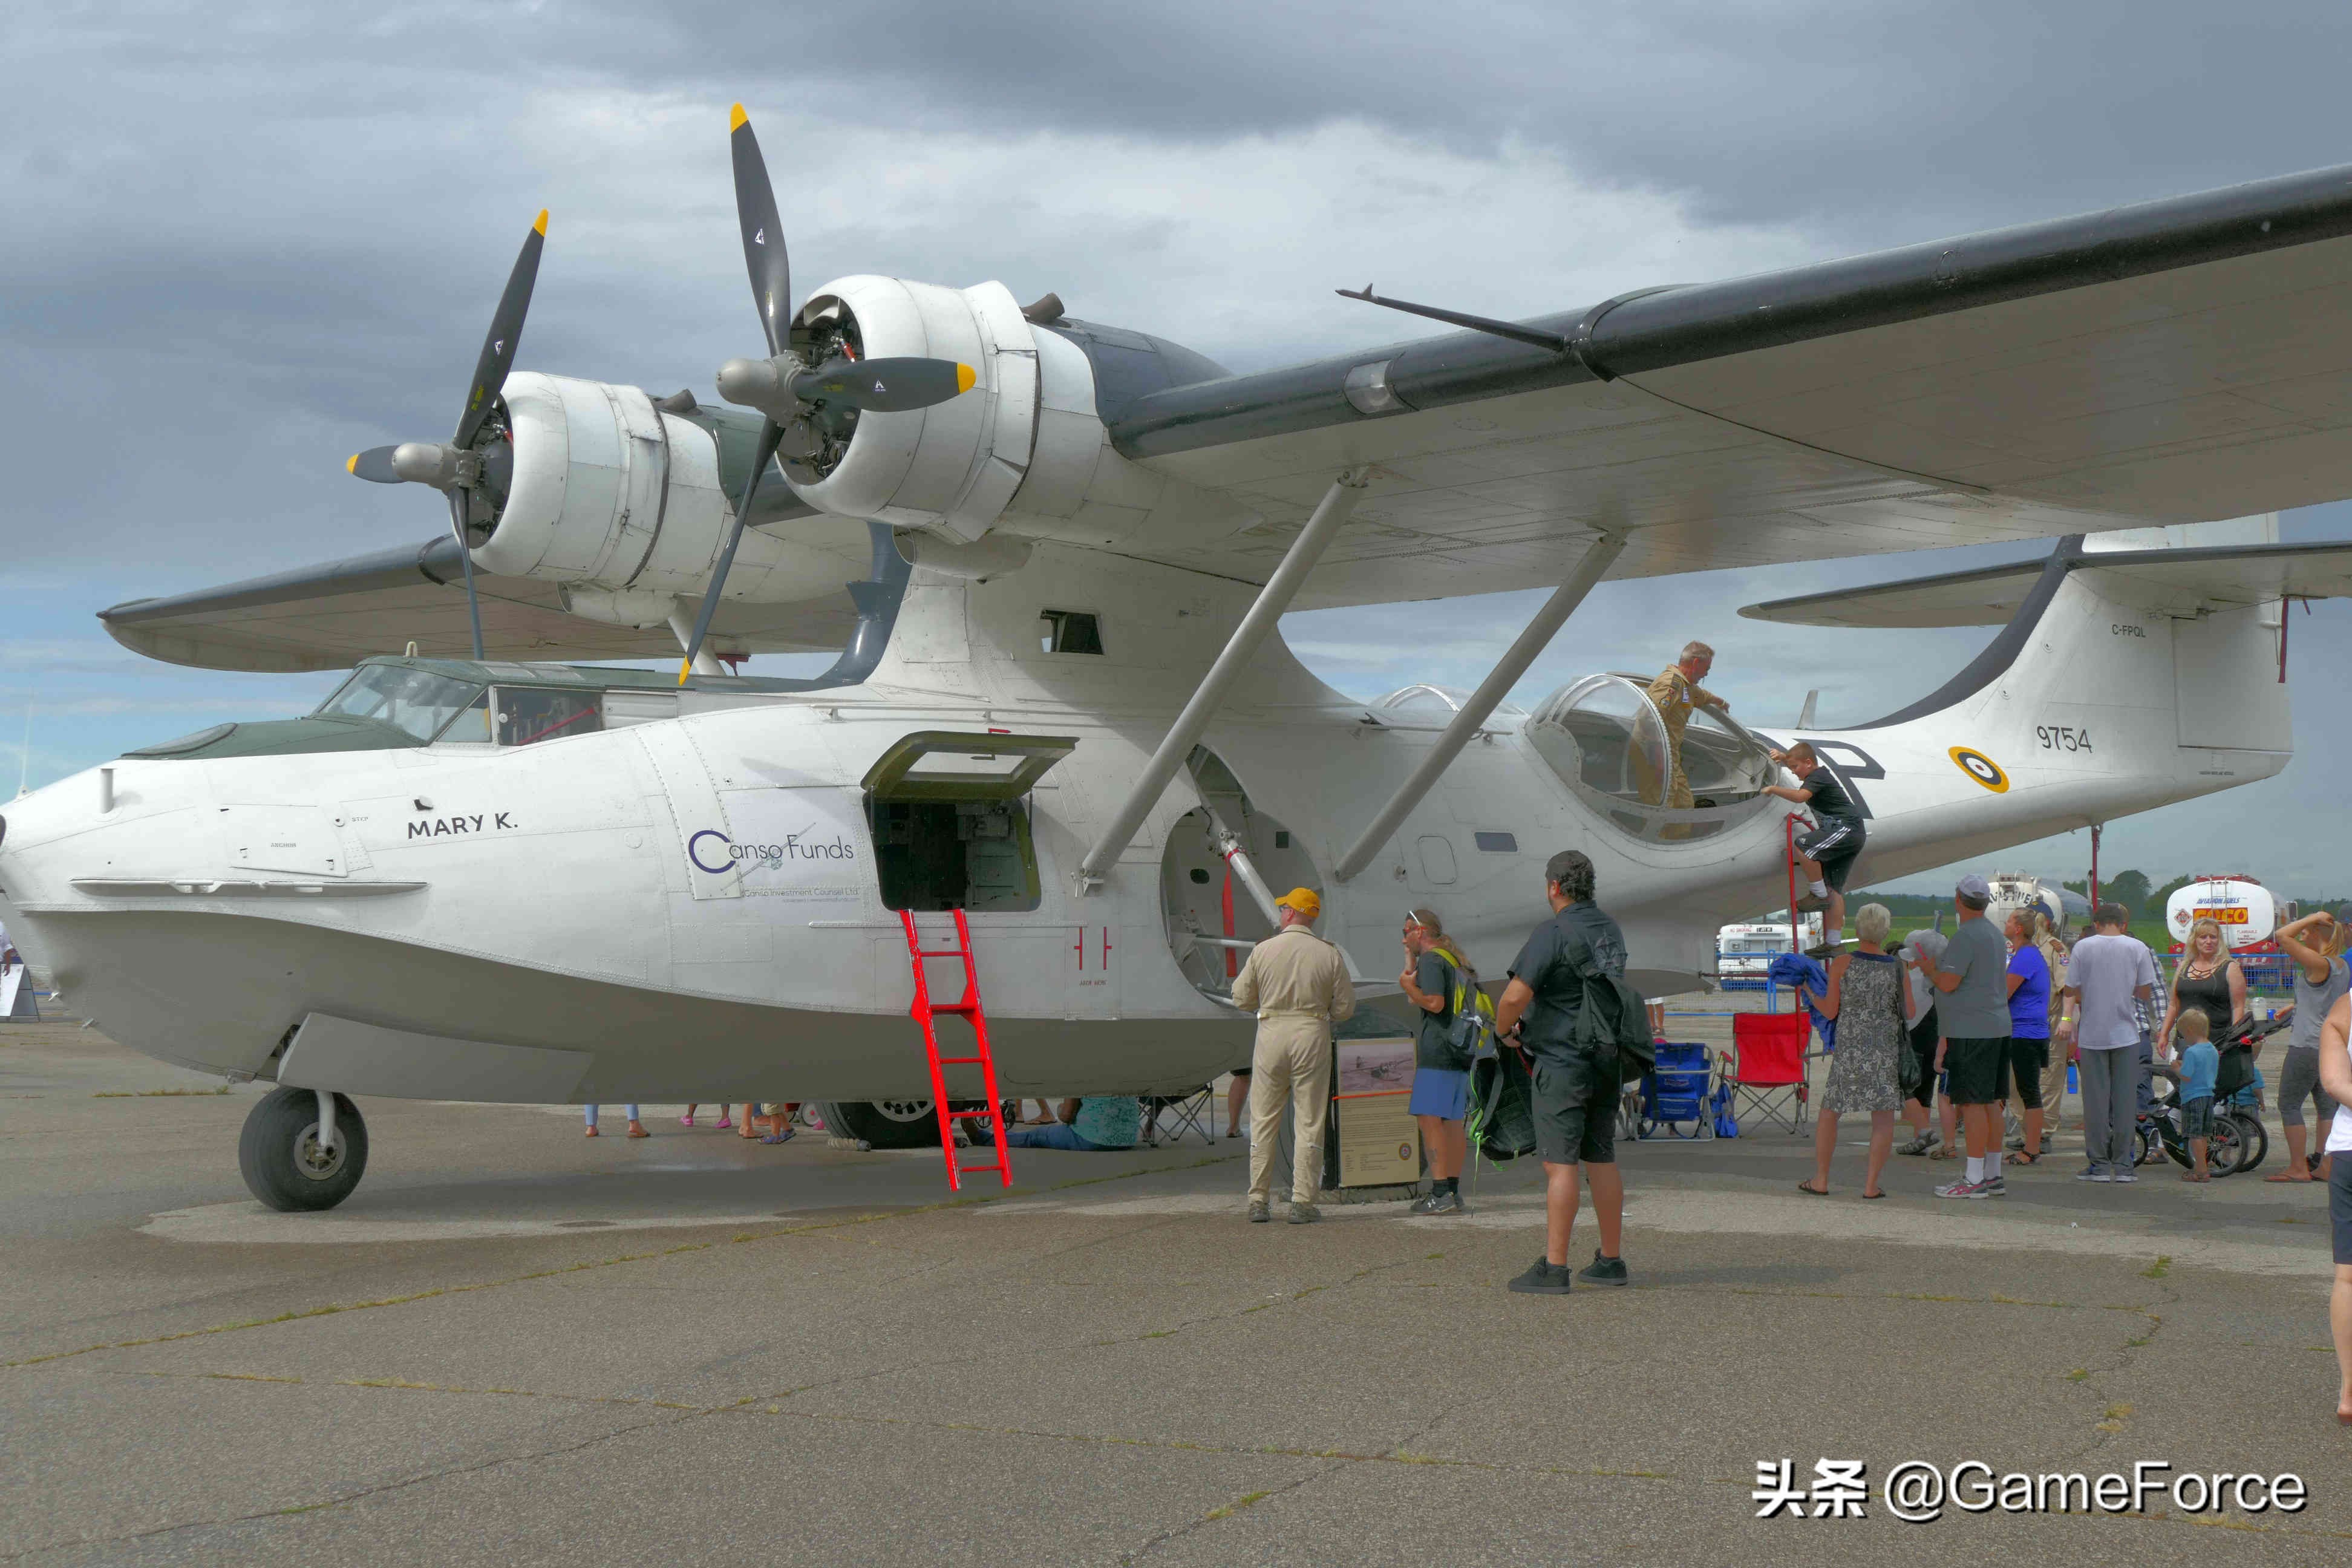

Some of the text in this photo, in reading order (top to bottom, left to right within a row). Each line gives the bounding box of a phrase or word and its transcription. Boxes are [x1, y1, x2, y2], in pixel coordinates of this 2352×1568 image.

[2112, 624, 2146, 637] C-FPQL
[2037, 726, 2092, 753] 9754
[408, 812, 518, 839] MARY K.
[688, 830, 854, 874] Canso Funds
